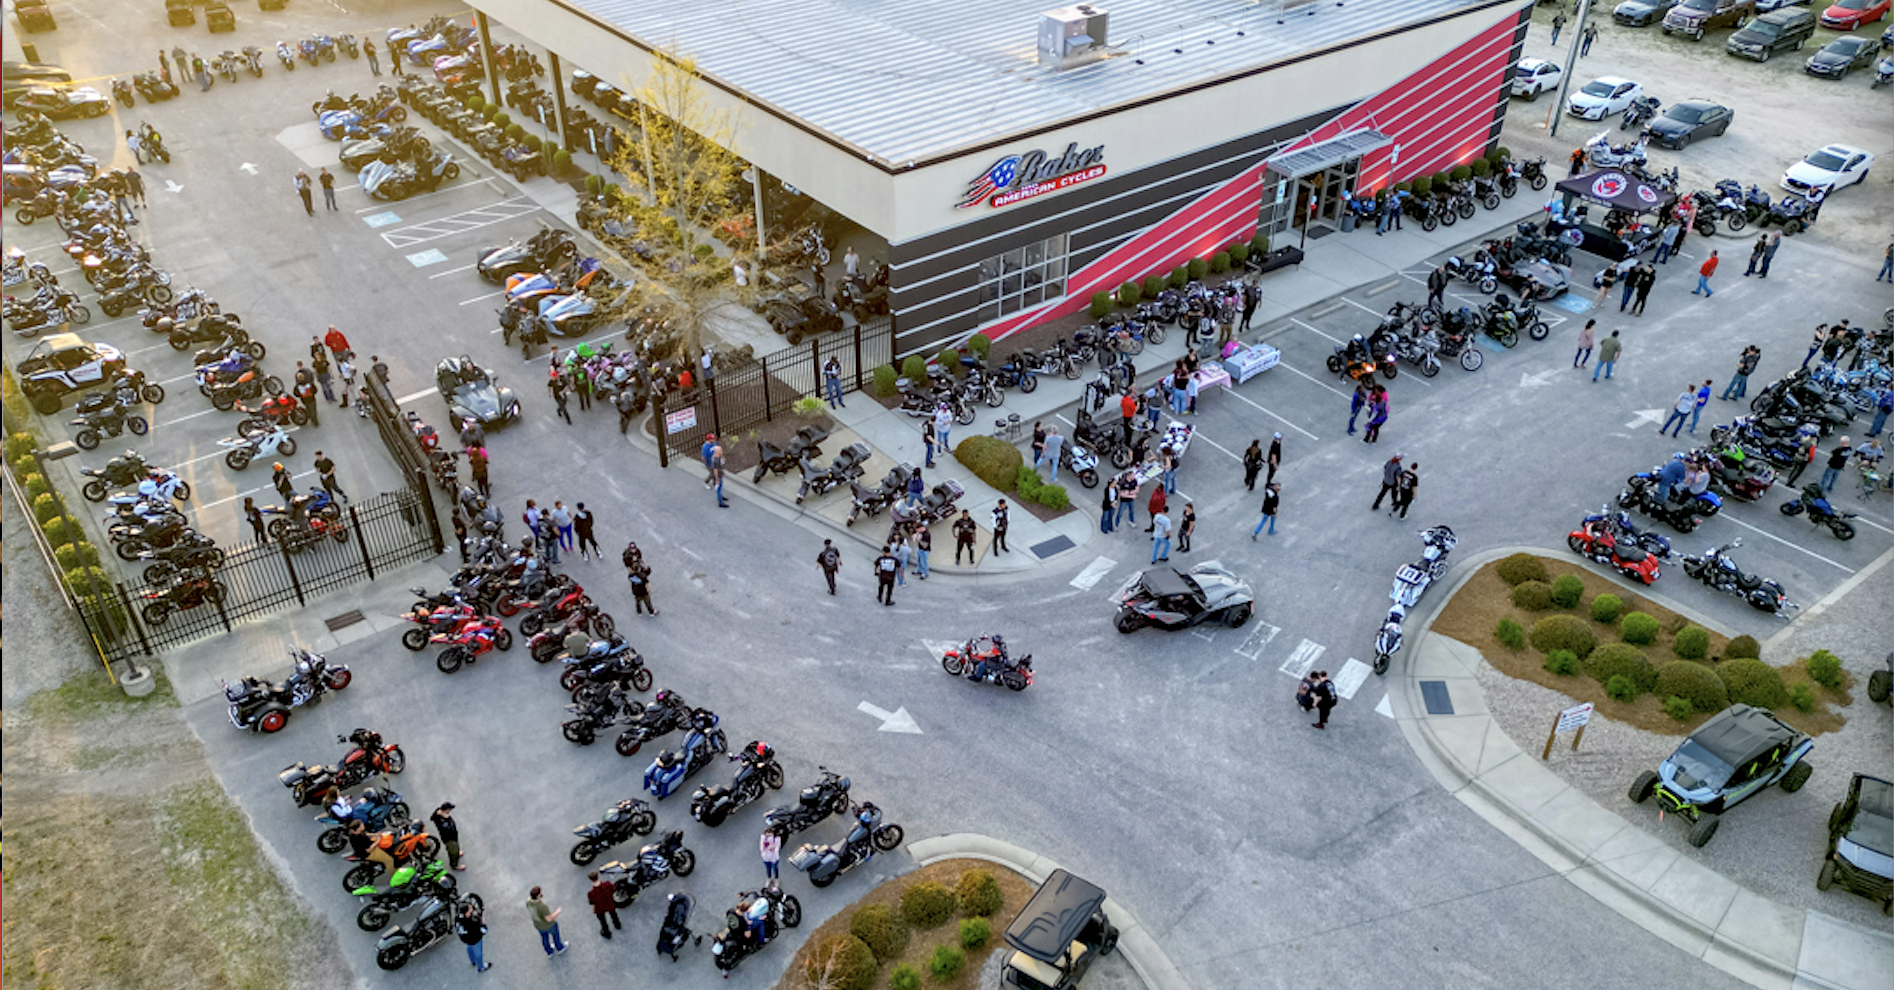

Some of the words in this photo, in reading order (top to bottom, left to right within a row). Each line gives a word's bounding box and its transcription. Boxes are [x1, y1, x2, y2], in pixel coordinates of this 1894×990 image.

[1010, 142, 1104, 188] Baker
[994, 181, 1056, 206] AMERICAN
[1060, 167, 1103, 187] CYCLES
